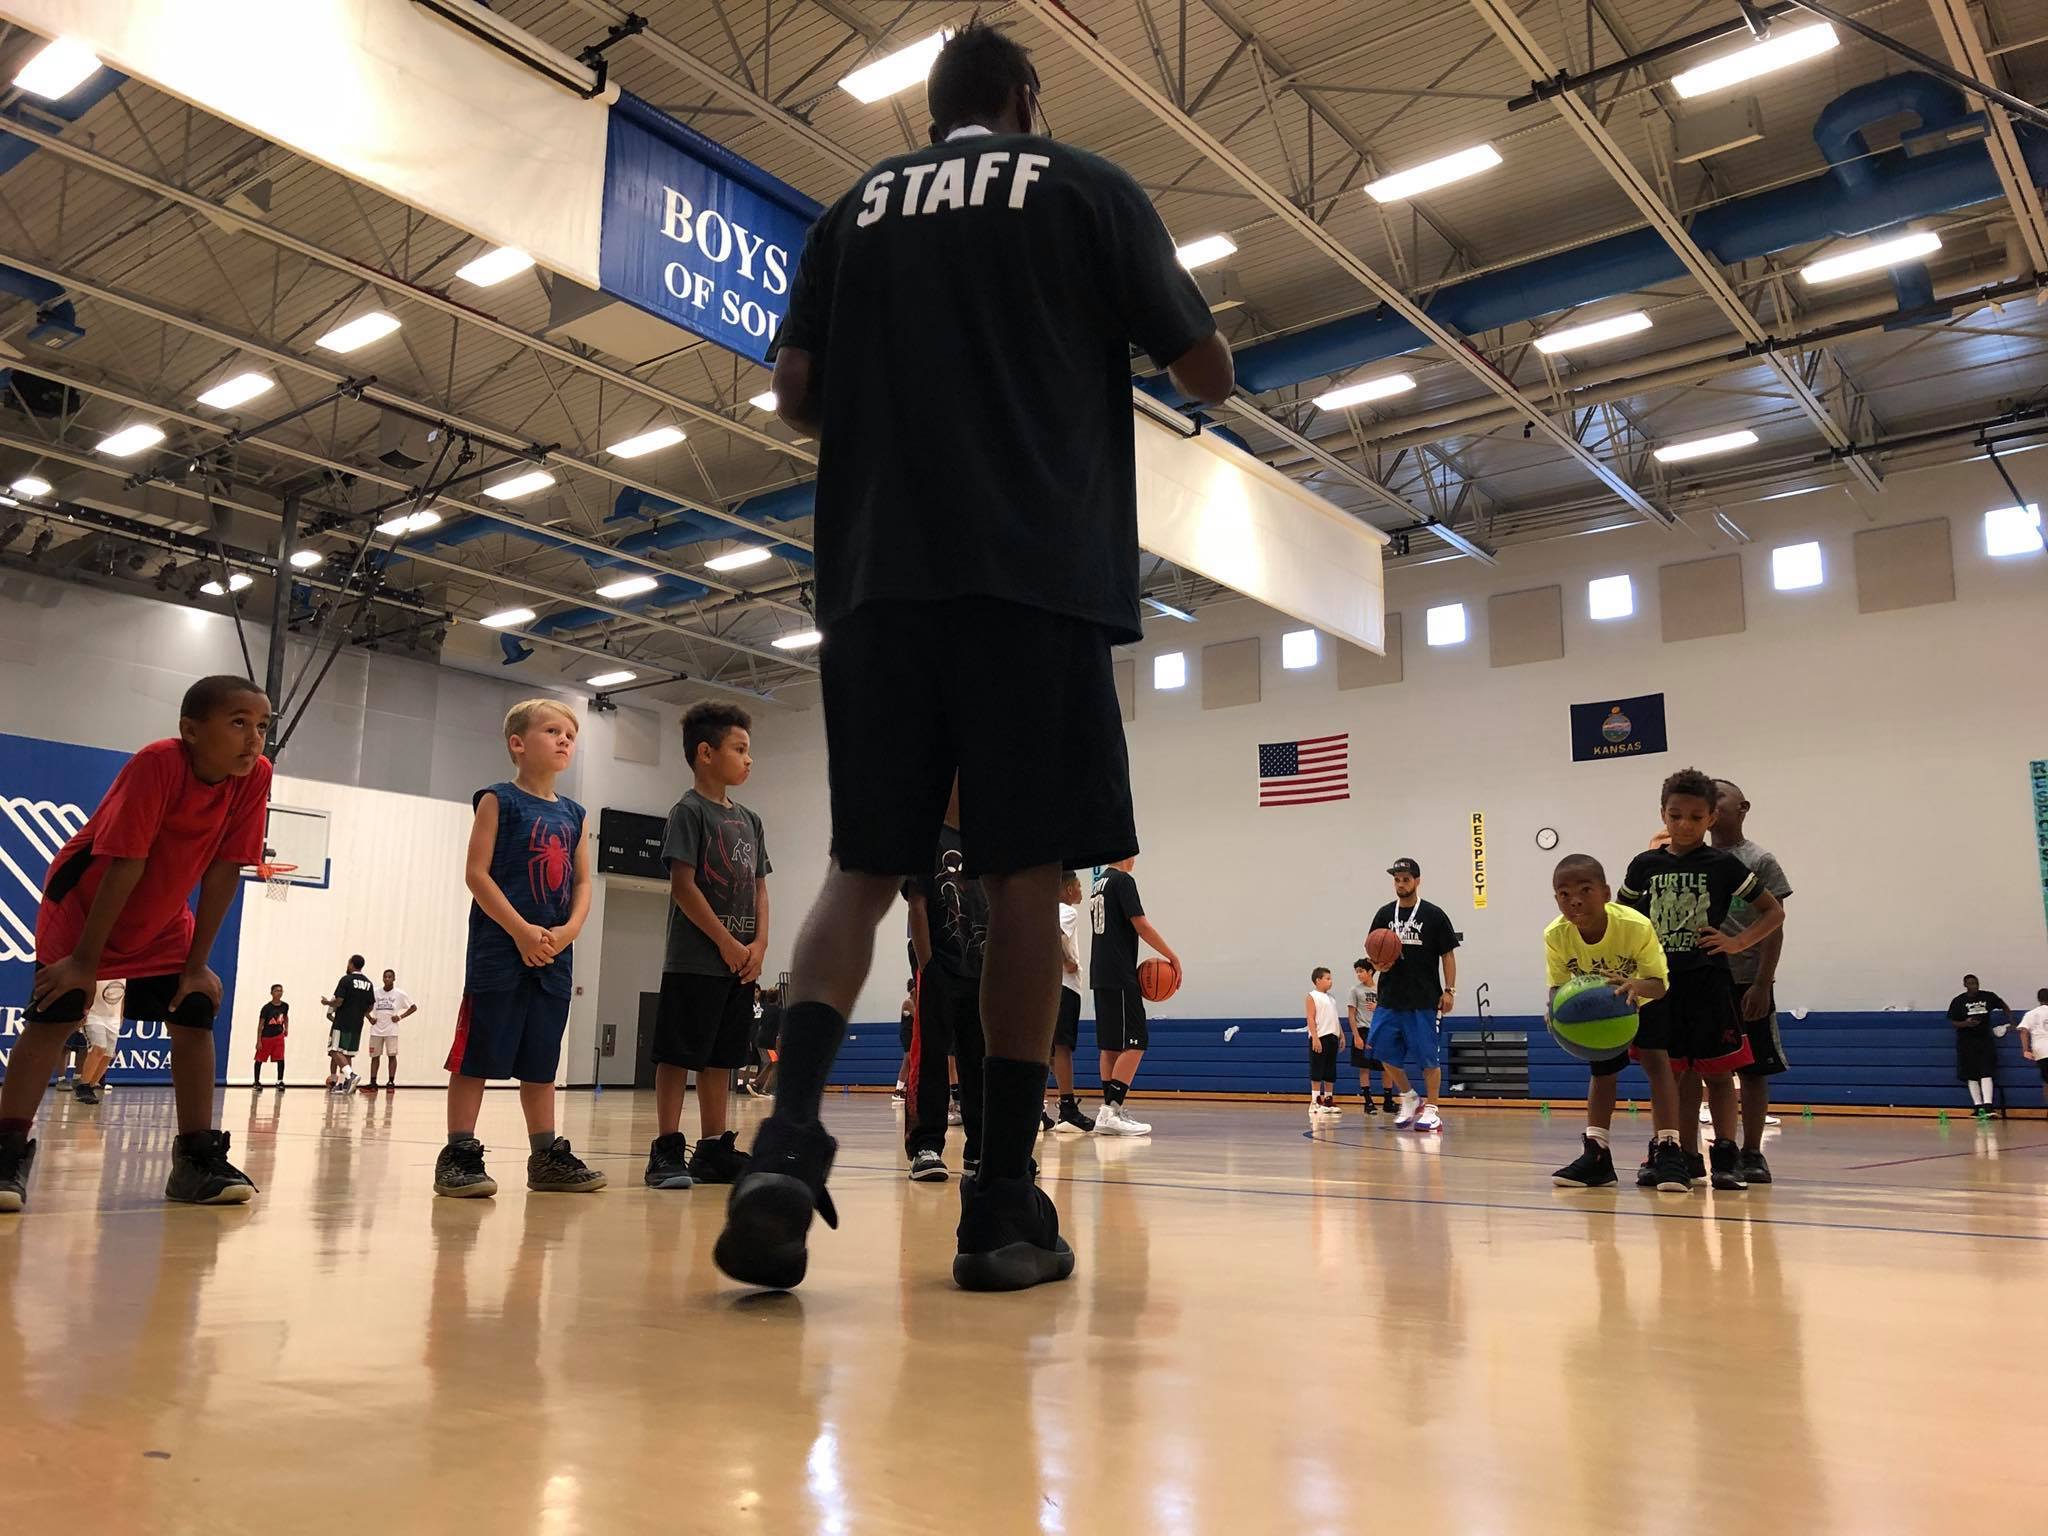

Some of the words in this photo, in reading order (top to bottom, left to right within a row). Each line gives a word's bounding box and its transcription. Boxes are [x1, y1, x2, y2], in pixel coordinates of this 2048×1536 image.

[857, 152, 1050, 228] STAFF
[660, 186, 788, 295] BOYS
[664, 262, 715, 310] OF
[1593, 741, 1642, 755] KANSAS
[1473, 813, 1485, 896] RESPECT
[1650, 873, 1707, 890] TURTLE
[108, 1050, 172, 1069] ANSA
